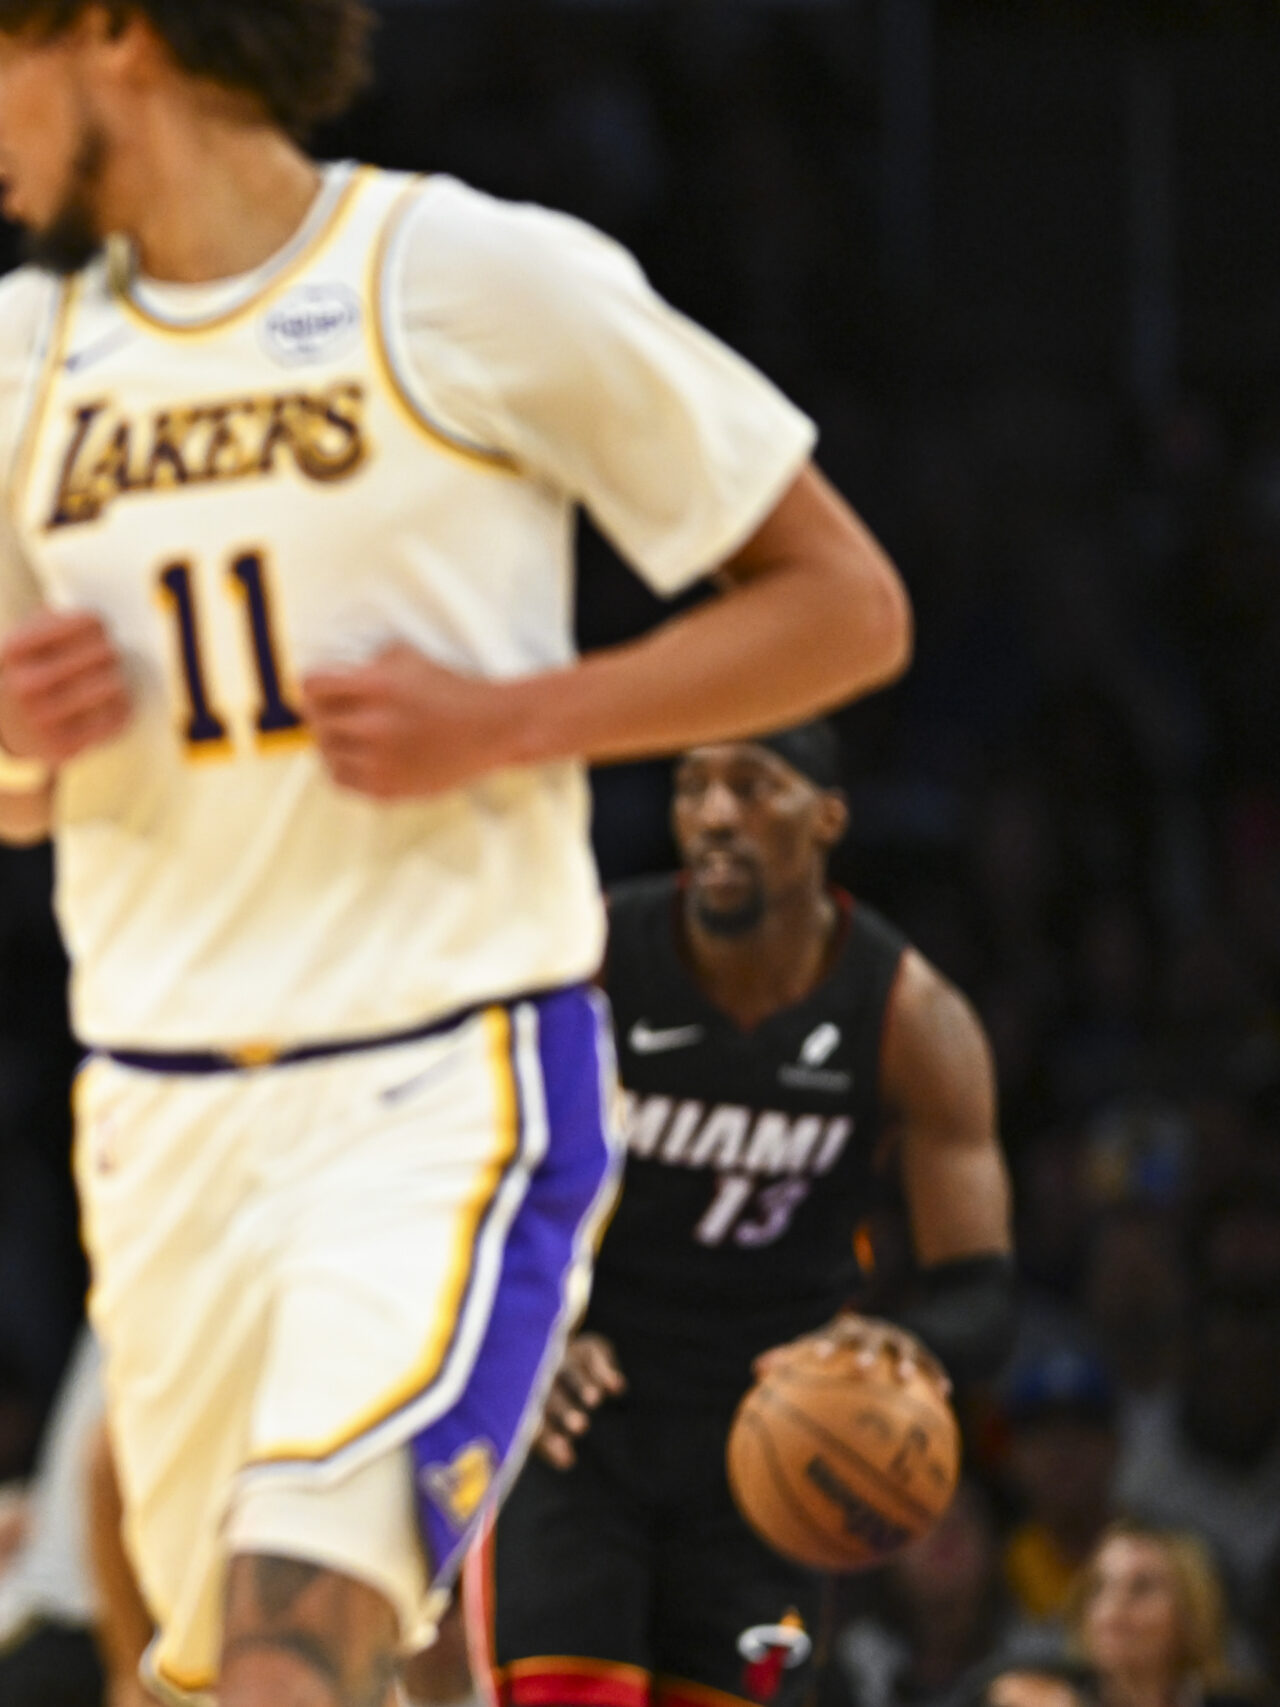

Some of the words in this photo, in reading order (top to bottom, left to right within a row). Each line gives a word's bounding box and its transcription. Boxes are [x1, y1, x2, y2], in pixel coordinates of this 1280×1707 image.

[43, 379, 370, 535] LAKERS
[154, 547, 314, 763] 11
[694, 1173, 808, 1246] 13
